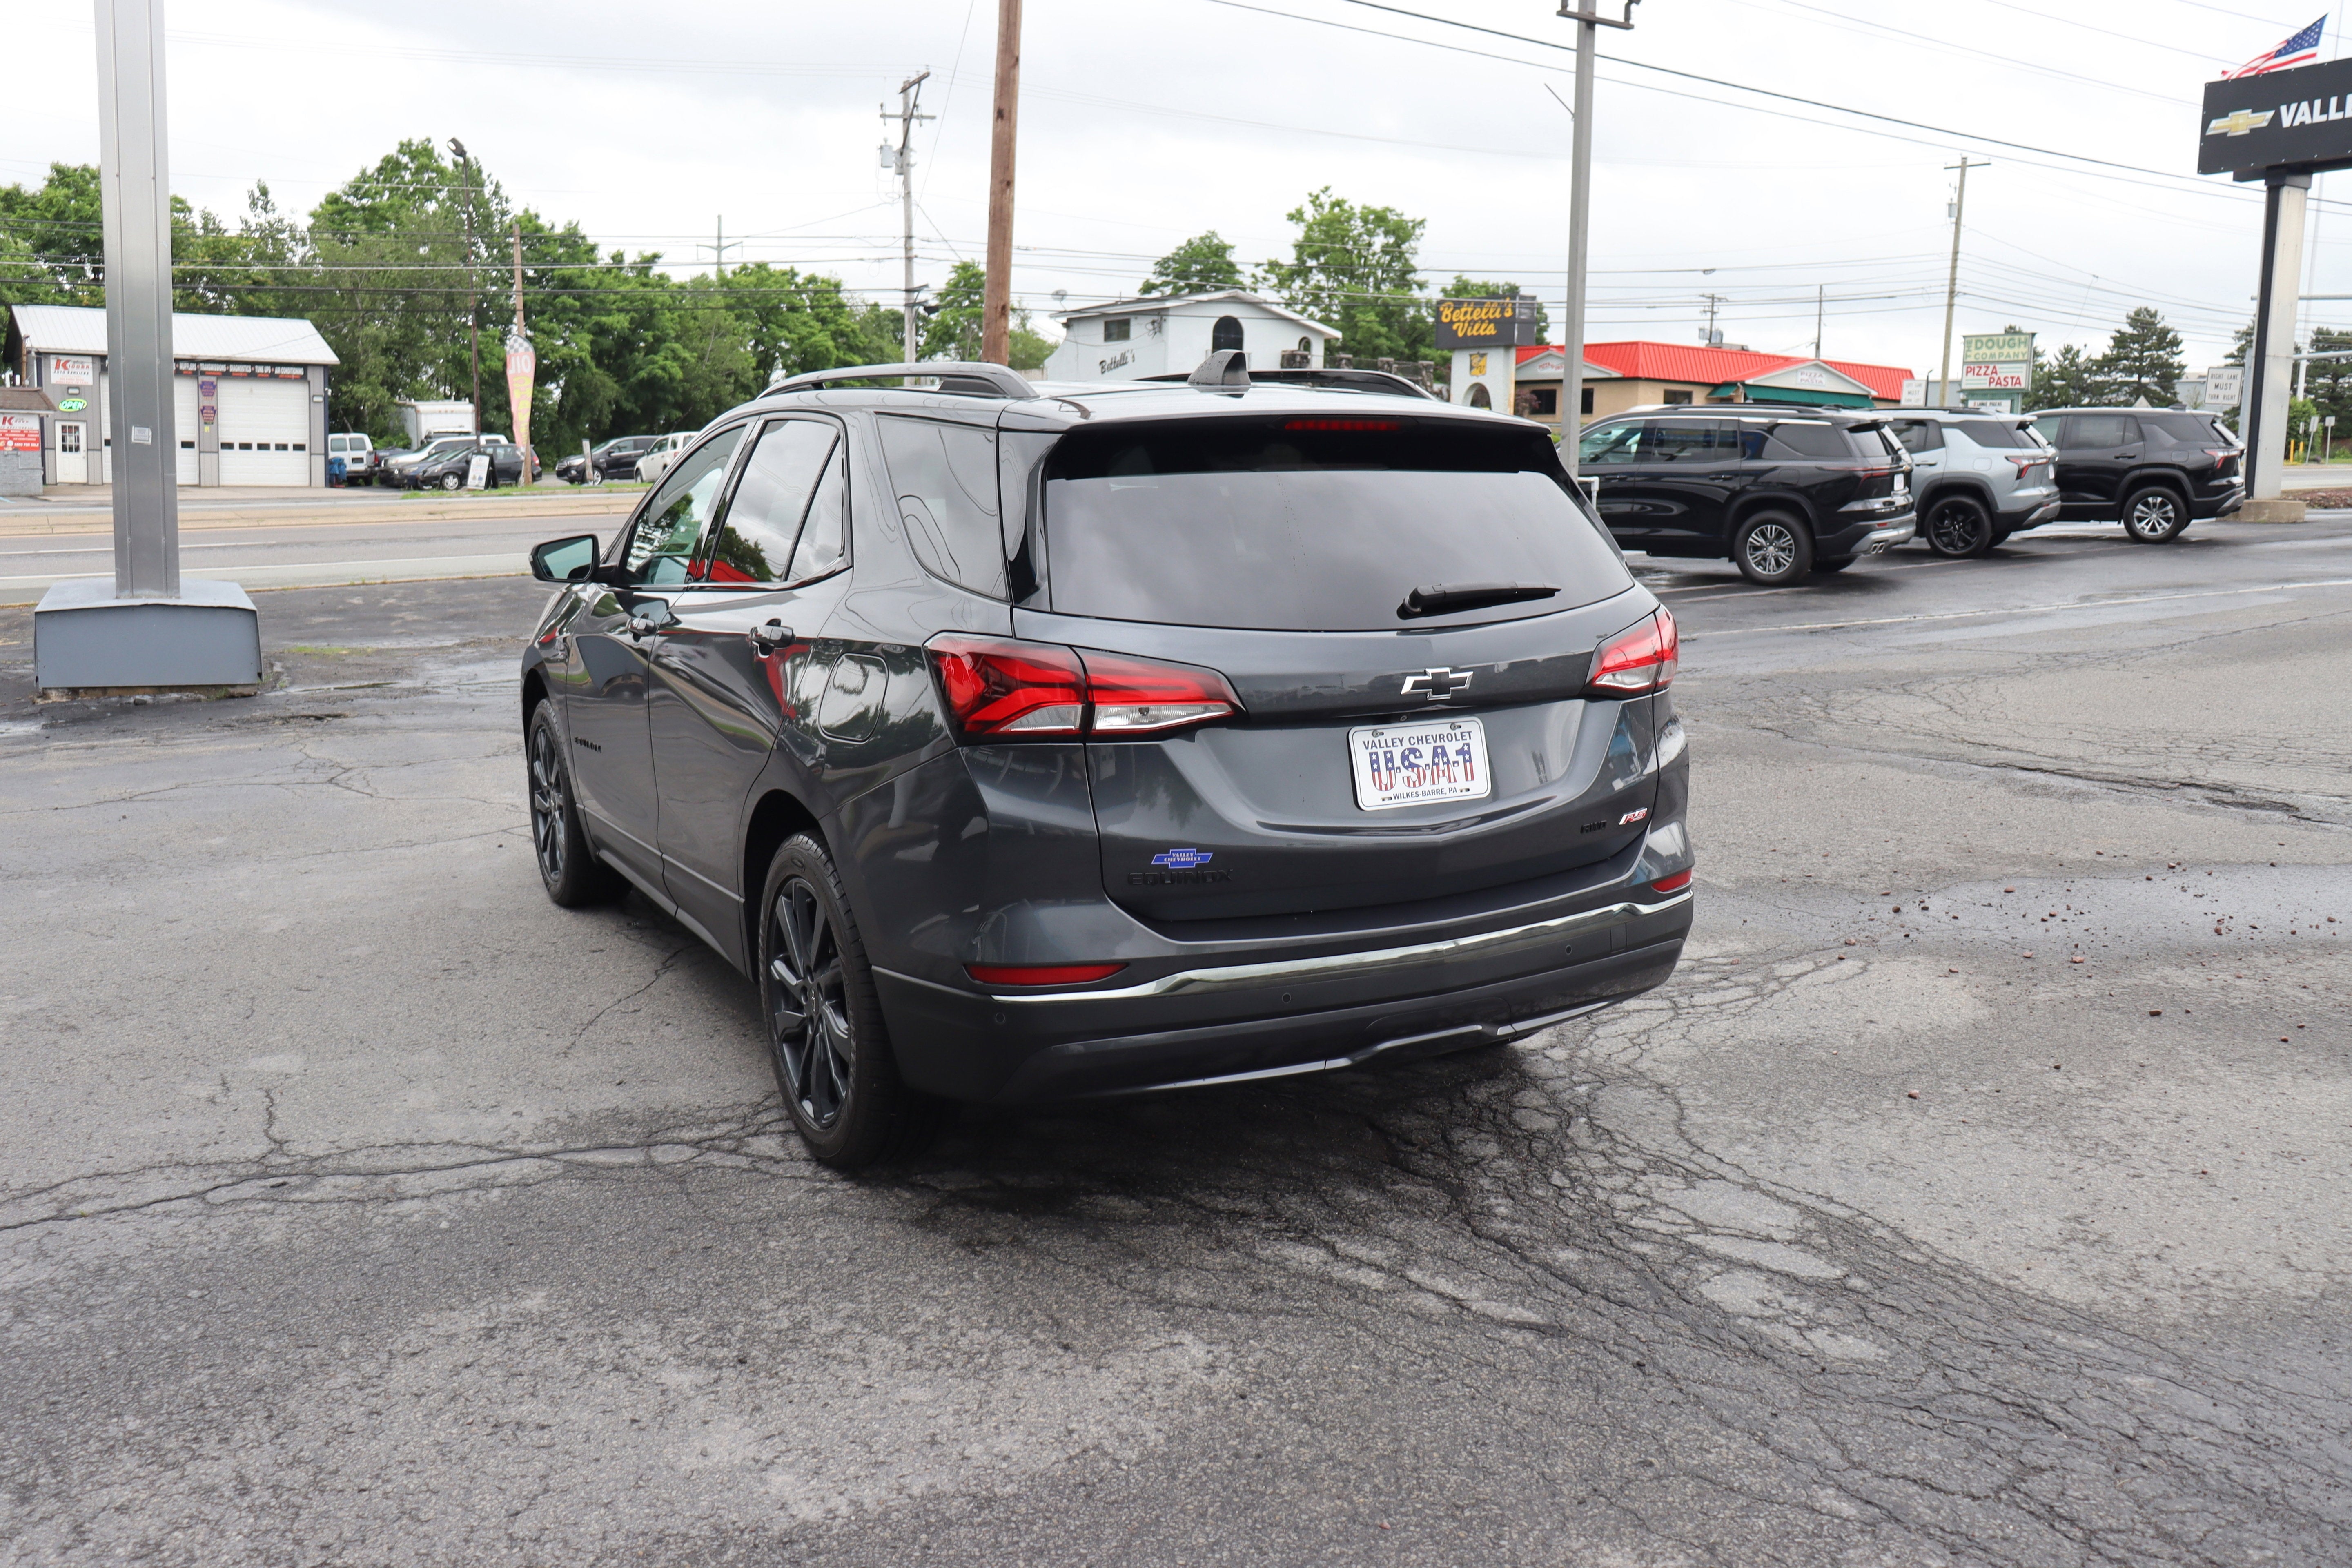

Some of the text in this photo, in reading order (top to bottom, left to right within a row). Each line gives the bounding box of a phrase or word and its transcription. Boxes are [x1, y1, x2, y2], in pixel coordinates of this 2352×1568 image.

[1439, 297, 1513, 323] Bettelli's
[1453, 321, 1497, 337] Villa
[1975, 337, 2027, 350] DOUGH
[1974, 352, 2027, 360] COMPANY
[1966, 365, 1998, 376] PIZZA
[1989, 376, 2021, 387] PASTA
[61, 400, 84, 410] OPEN
[1363, 731, 1472, 750] VALLEY CHEVROLET
[1393, 788, 1447, 800] WILKES-BARRE,
[1619, 807, 1647, 825] RS
[1580, 820, 1607, 834] AWD
[1128, 869, 1233, 885] EQUINOX
